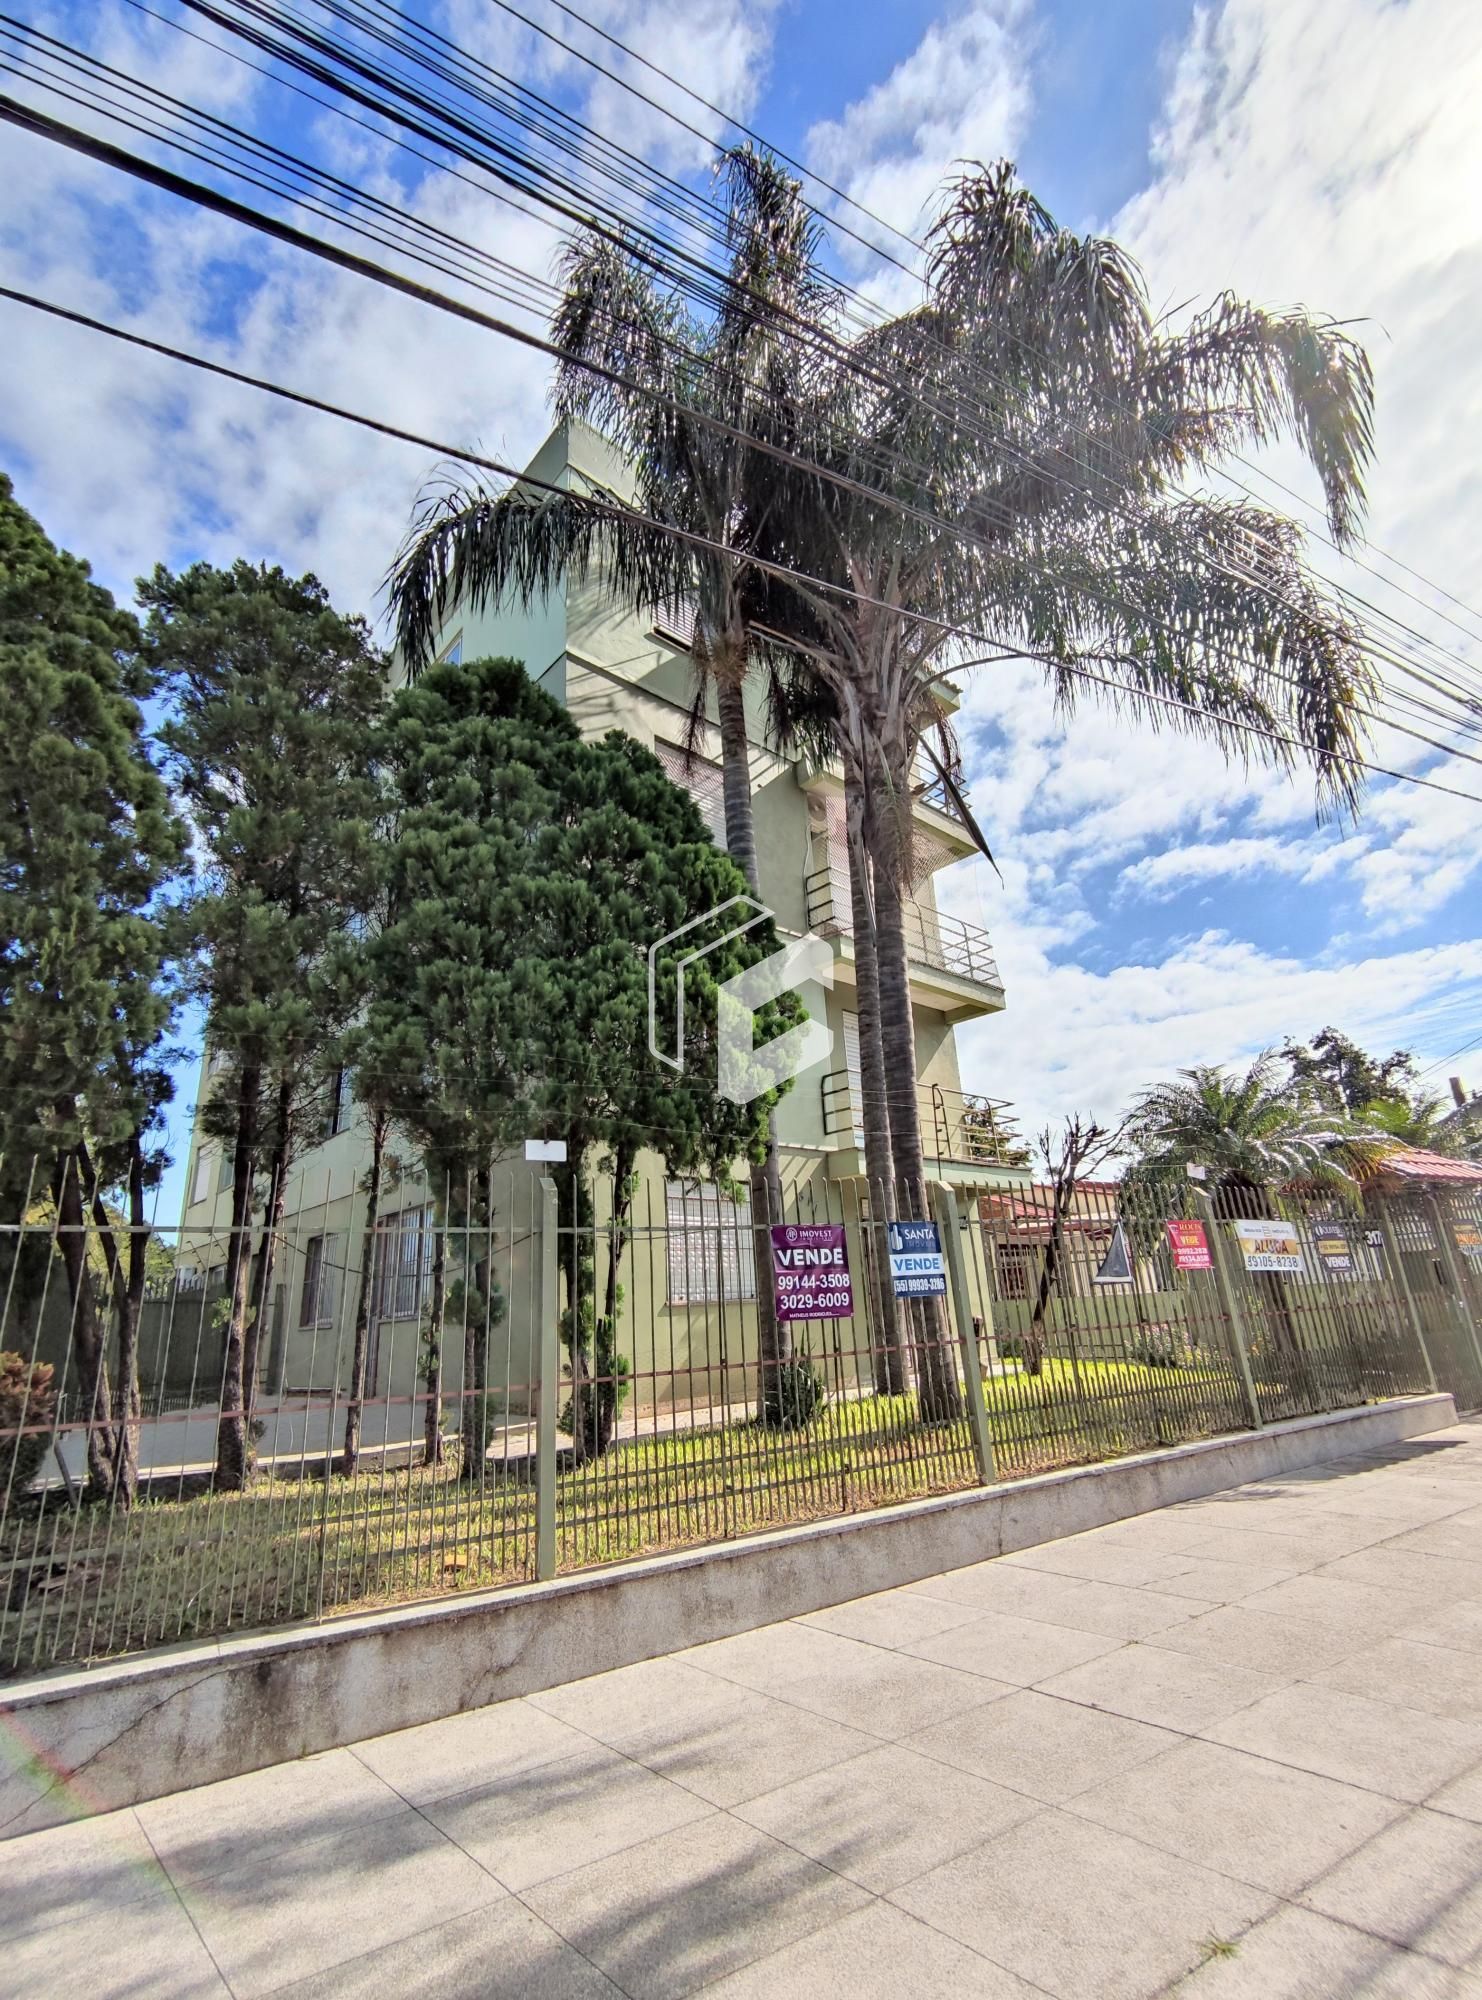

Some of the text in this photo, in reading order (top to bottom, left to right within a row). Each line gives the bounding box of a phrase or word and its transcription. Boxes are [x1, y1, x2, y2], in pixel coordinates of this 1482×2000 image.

[800, 1230, 832, 1238] IMOVEST
[904, 1229, 935, 1240] SANTA
[1364, 1230, 1382, 1245] 317
[1255, 1239, 1290, 1254] ALUGA
[777, 1248, 844, 1266] VENDE
[893, 1258, 941, 1271] VENDE
[1324, 1256, 1351, 1268] VENDE
[778, 1273, 850, 1290] 99144-3508
[780, 1292, 849, 1310] 3029-6009
